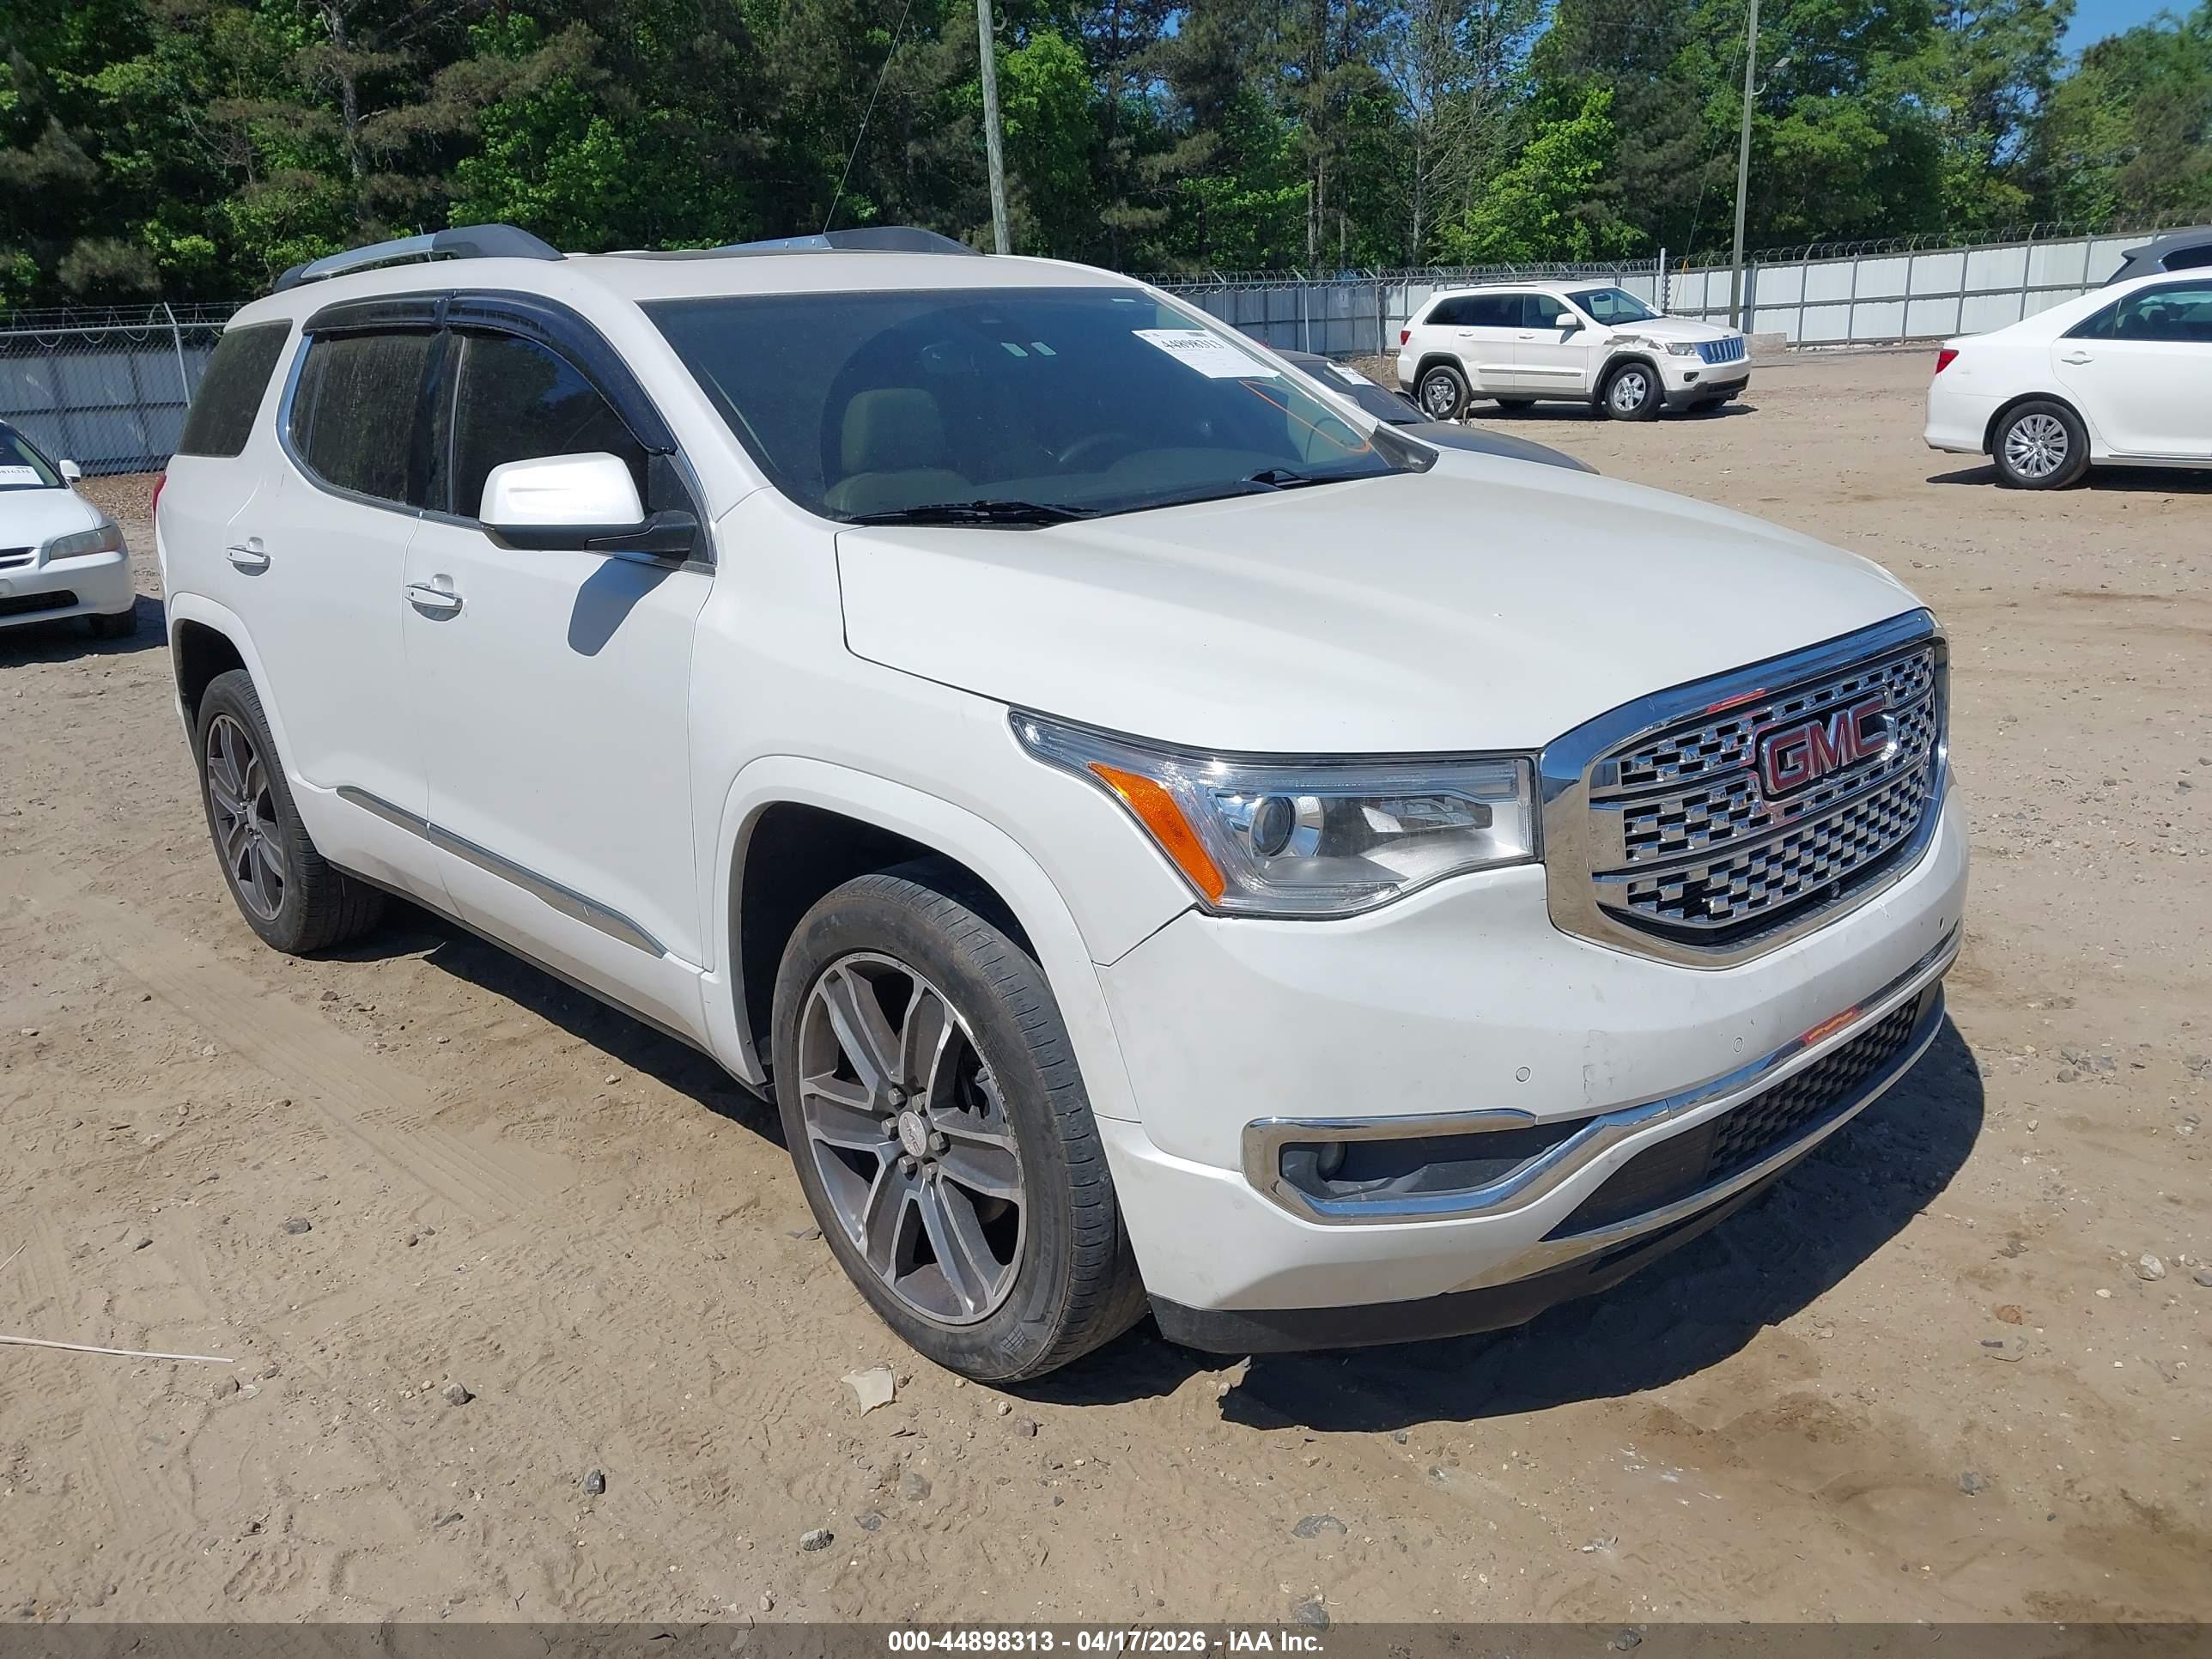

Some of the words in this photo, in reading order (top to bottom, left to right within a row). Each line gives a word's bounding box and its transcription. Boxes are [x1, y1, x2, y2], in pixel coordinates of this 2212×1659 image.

[1161, 338, 1225, 349] 44898313
[1762, 694, 1889, 795] GMC
[902, 1115, 921, 1155] GMC
